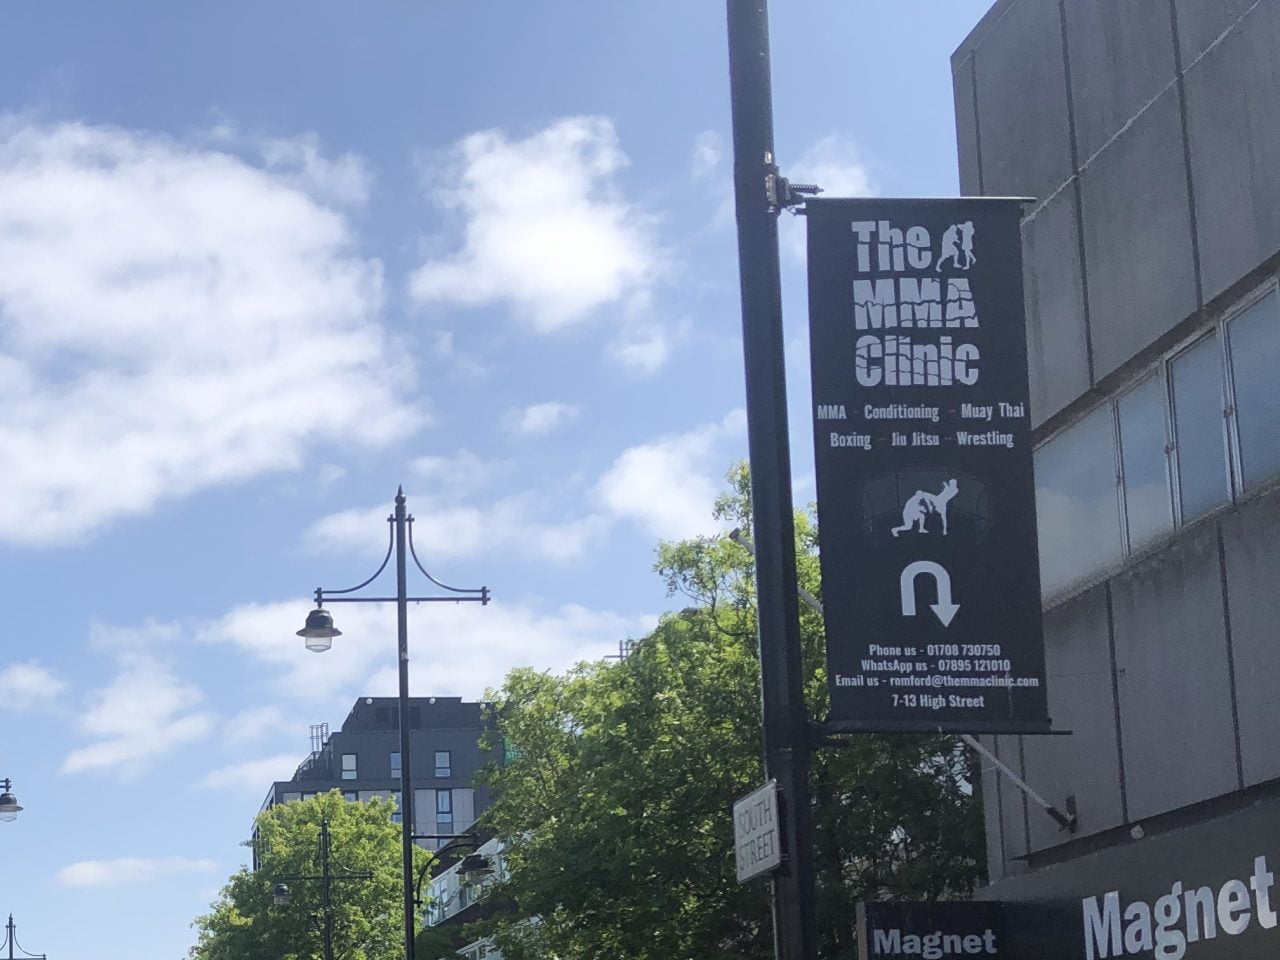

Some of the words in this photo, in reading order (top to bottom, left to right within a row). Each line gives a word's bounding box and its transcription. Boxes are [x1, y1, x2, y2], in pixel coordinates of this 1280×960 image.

[851, 220, 932, 272] The
[853, 277, 980, 330] MMA
[855, 335, 980, 387] Clinic
[817, 404, 847, 419] MMA
[864, 404, 940, 422] Conditioning
[961, 403, 993, 421] Muay
[998, 402, 1025, 418] Thai
[830, 432, 872, 450] Boxing
[891, 432, 907, 446] Jiu
[911, 431, 940, 446] Jitsu
[956, 431, 1014, 448] Wrestling
[869, 644, 902, 656] Phone
[904, 647, 917, 656] us
[927, 644, 960, 656] 01708
[961, 644, 1001, 656] 730750
[861, 660, 913, 673] WhatsApp
[915, 663, 928, 672] us
[938, 659, 971, 671] 07895
[973, 659, 1011, 671] 121010
[835, 675, 864, 686] Email
[866, 678, 879, 687] us
[890, 674, 1039, 688] romford@themmaclinic.com
[892, 694, 917, 707] 7-13
[920, 694, 946, 709] High
[949, 694, 985, 707] Street
[739, 796, 772, 838] SOUTH
[740, 828, 775, 870] STREET
[872, 928, 998, 960] Magnet
